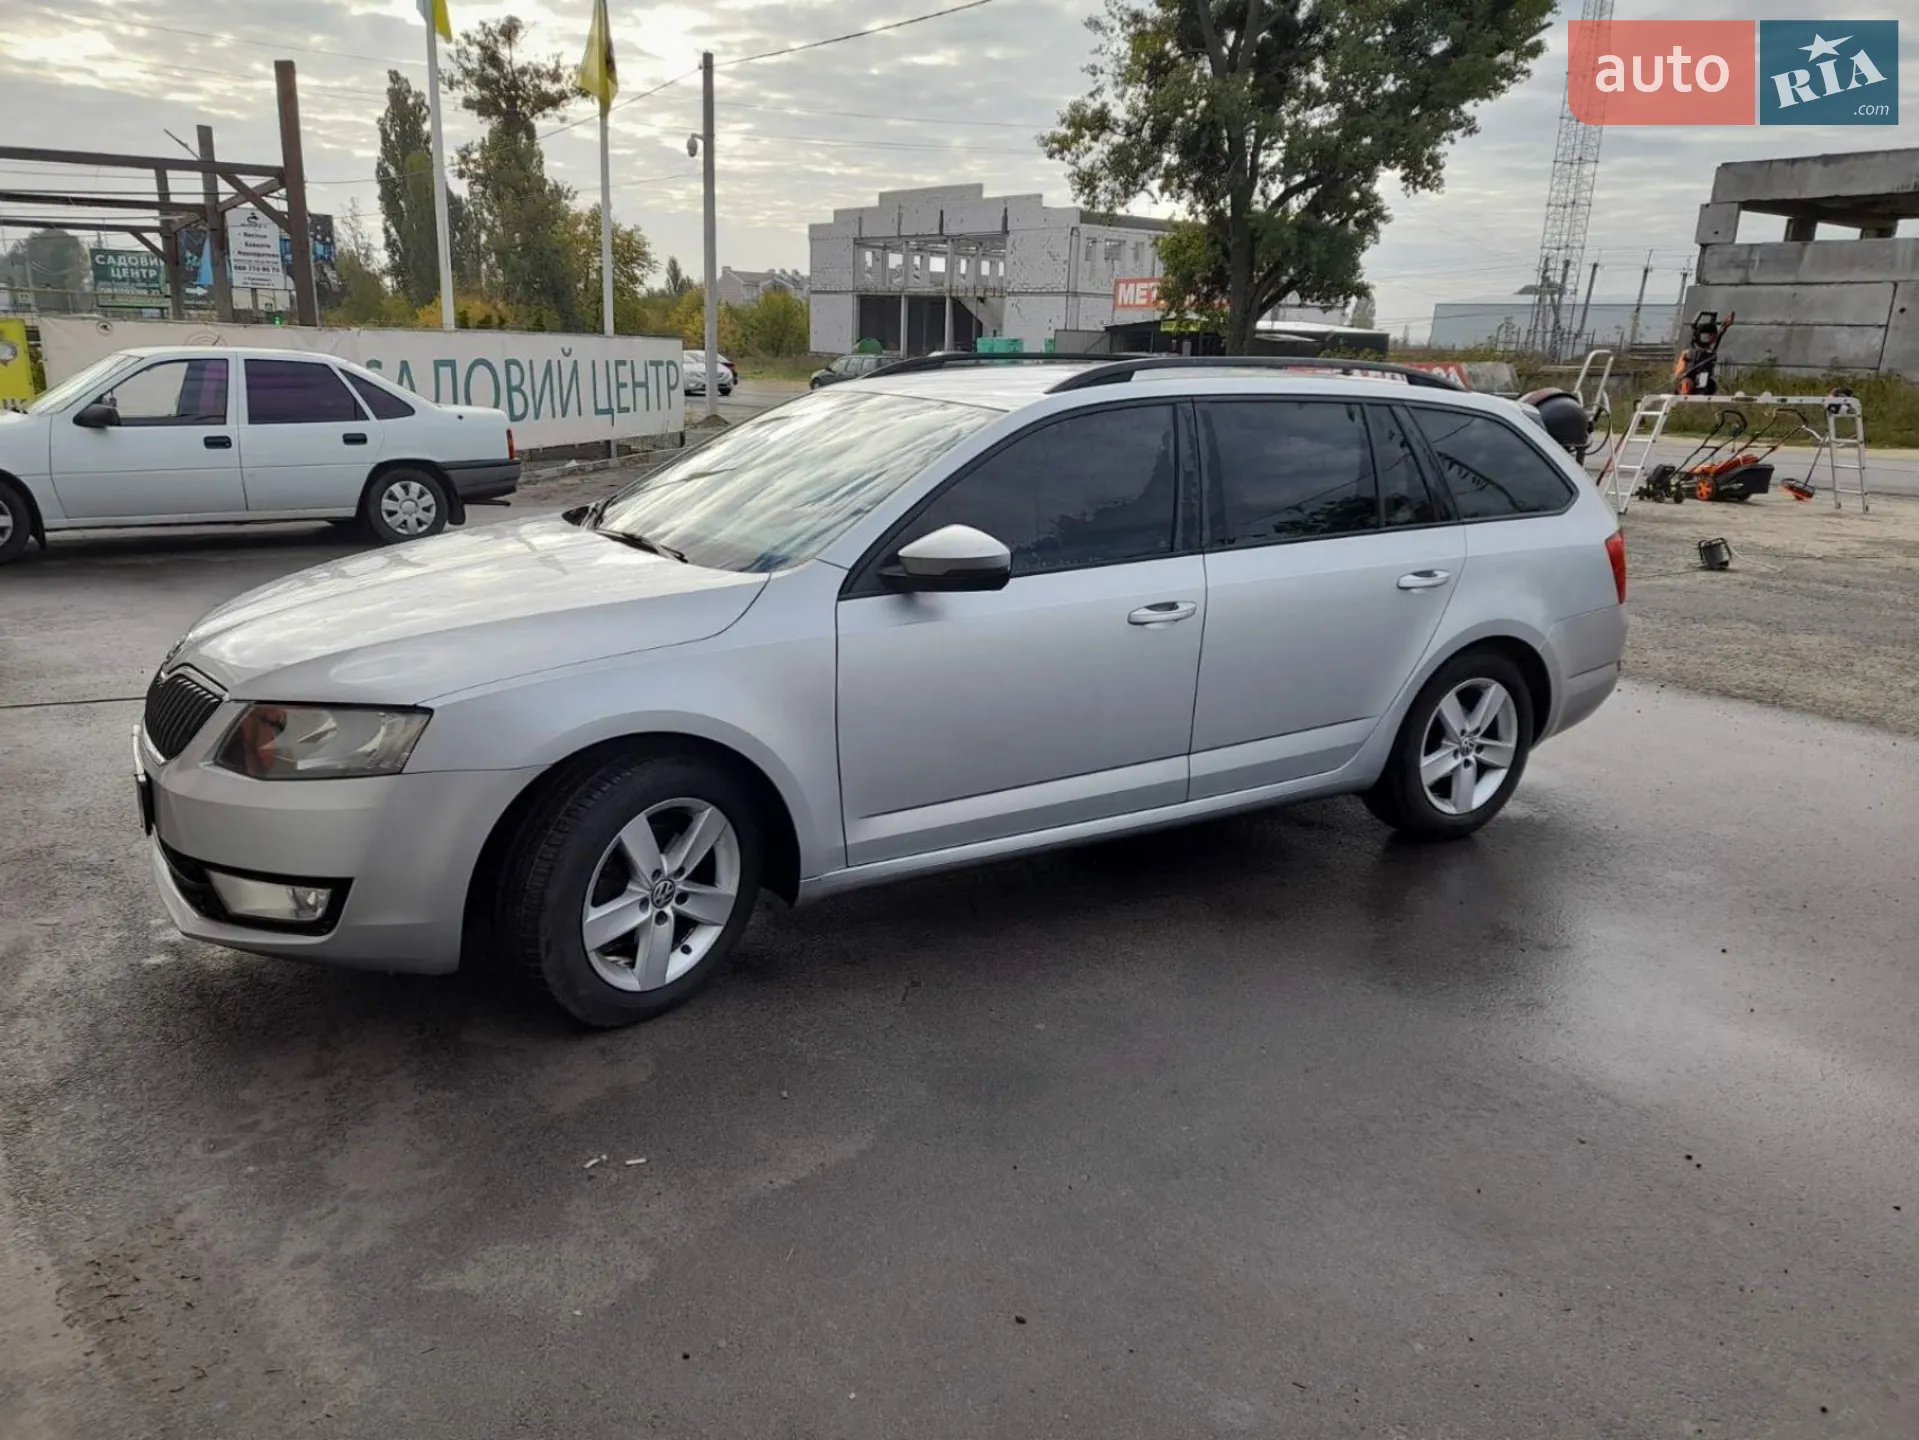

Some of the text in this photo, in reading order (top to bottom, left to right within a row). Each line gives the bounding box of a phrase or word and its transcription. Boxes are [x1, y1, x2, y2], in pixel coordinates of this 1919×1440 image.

[110, 267, 158, 279] ЦЕНТР
[366, 347, 680, 427] АДОВИЙ ЦЕНТР
